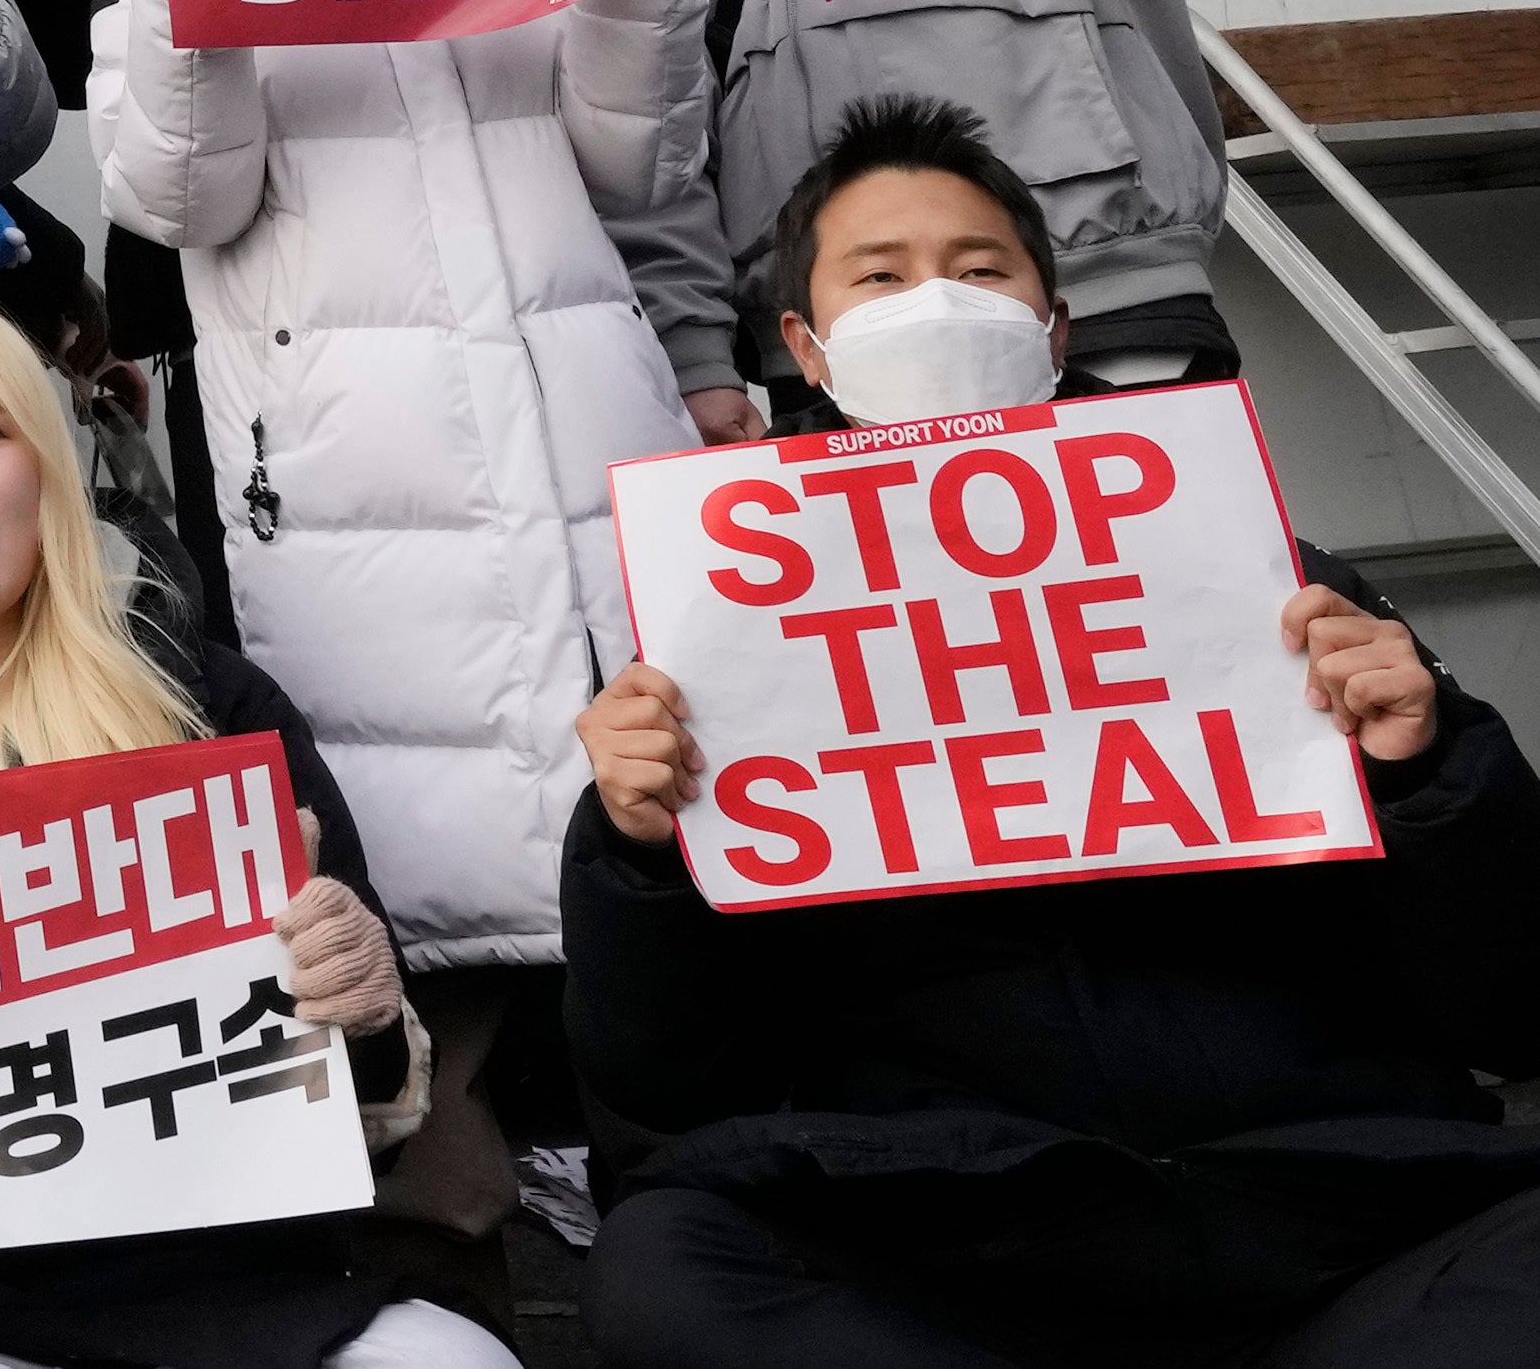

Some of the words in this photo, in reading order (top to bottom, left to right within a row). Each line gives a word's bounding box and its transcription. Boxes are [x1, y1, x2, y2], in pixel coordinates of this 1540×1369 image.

[826, 424, 936, 456] SUPPORT
[938, 412, 1005, 440] YOON
[699, 431, 1177, 608] STOP
[779, 573, 1170, 737] THE
[713, 708, 1326, 887] STEAL
[100, 974, 333, 1142] 구속
